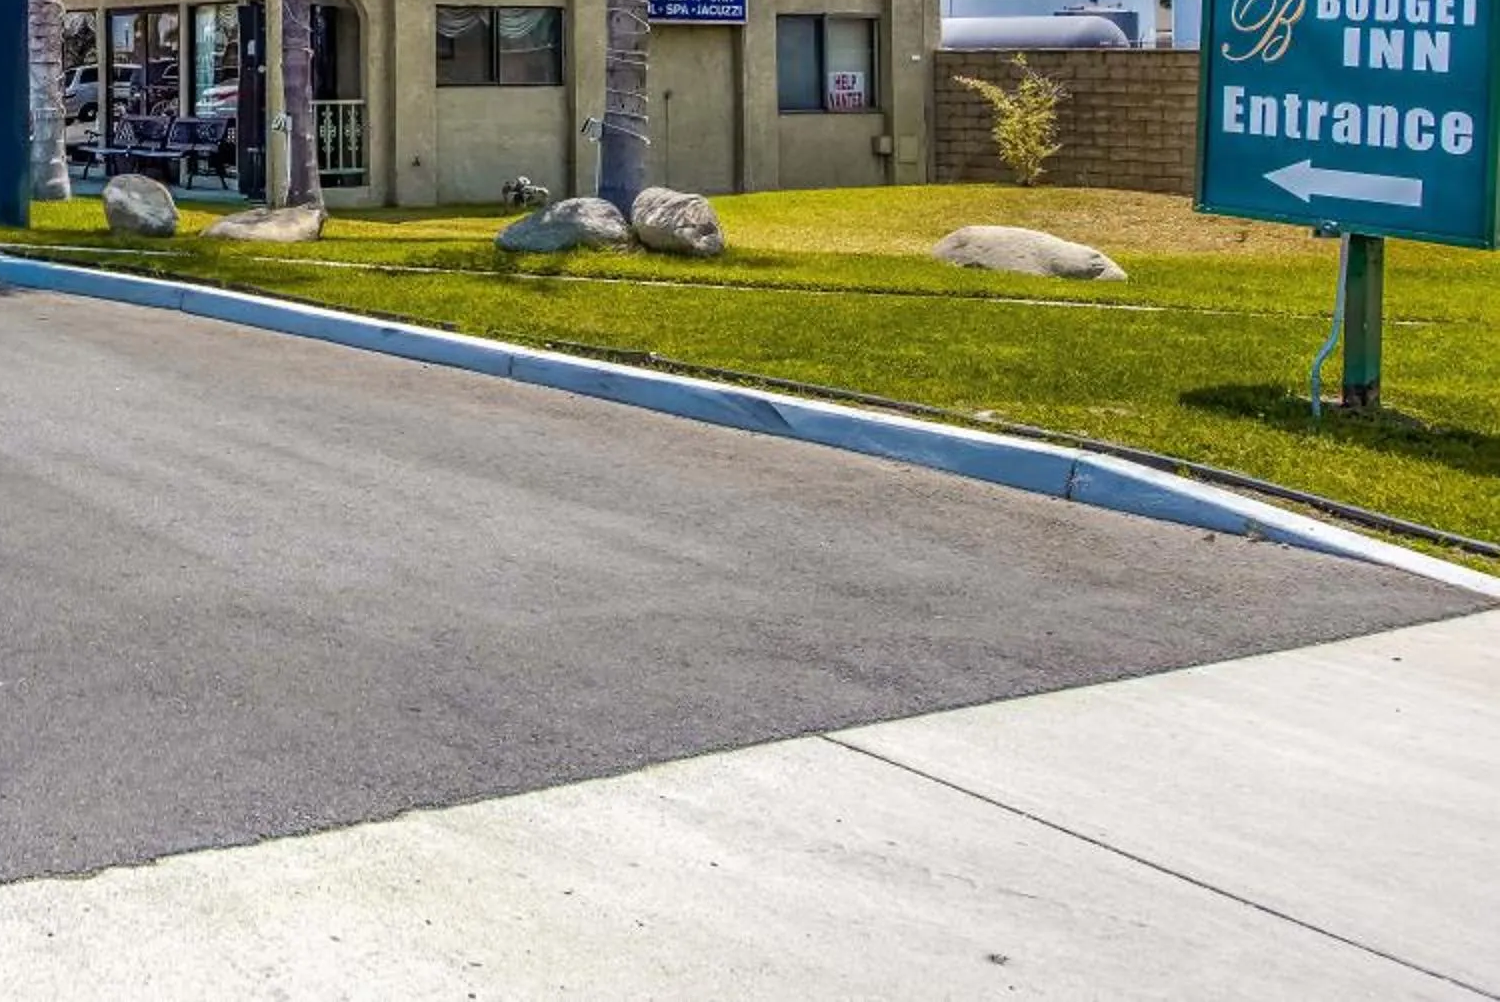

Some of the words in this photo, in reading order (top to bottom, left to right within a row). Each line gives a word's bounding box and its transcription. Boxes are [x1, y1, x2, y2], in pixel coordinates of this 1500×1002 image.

[665, 3, 689, 15] SPA
[1343, 27, 1450, 73] INN
[835, 73, 856, 90] HELP
[1222, 85, 1474, 155] Entrance
